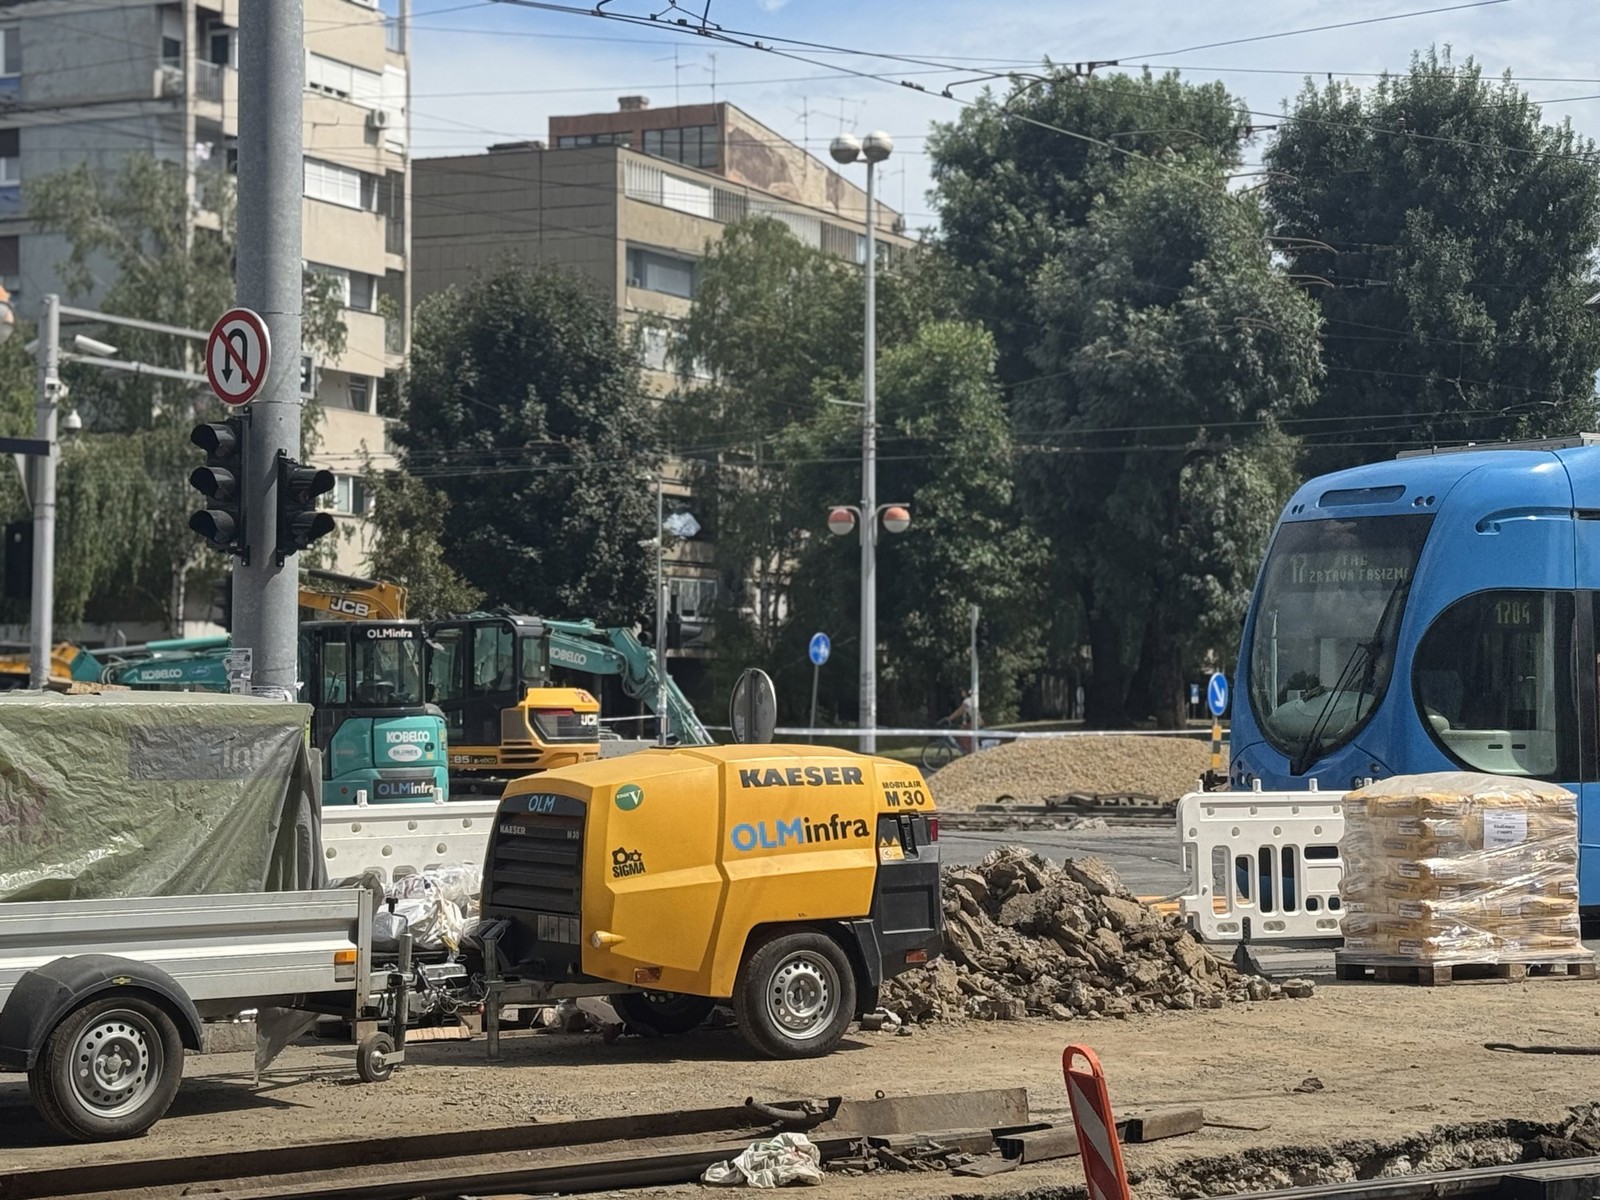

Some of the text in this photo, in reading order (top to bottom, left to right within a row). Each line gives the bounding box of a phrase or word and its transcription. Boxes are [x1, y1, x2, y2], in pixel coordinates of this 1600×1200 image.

[330, 598, 370, 617] JCB
[1495, 602, 1530, 625] 1704
[366, 628, 413, 639] OLMinfra
[141, 668, 183, 680] KOBELCO
[386, 731, 430, 743] KOBELCO
[739, 765, 865, 789] KAESER
[527, 795, 556, 812] OLM
[629, 789, 642, 806] V
[885, 789, 925, 807] M 30
[500, 824, 526, 835] KAESER
[731, 813, 870, 851] OLMinfra
[612, 860, 646, 878] SIGMA
